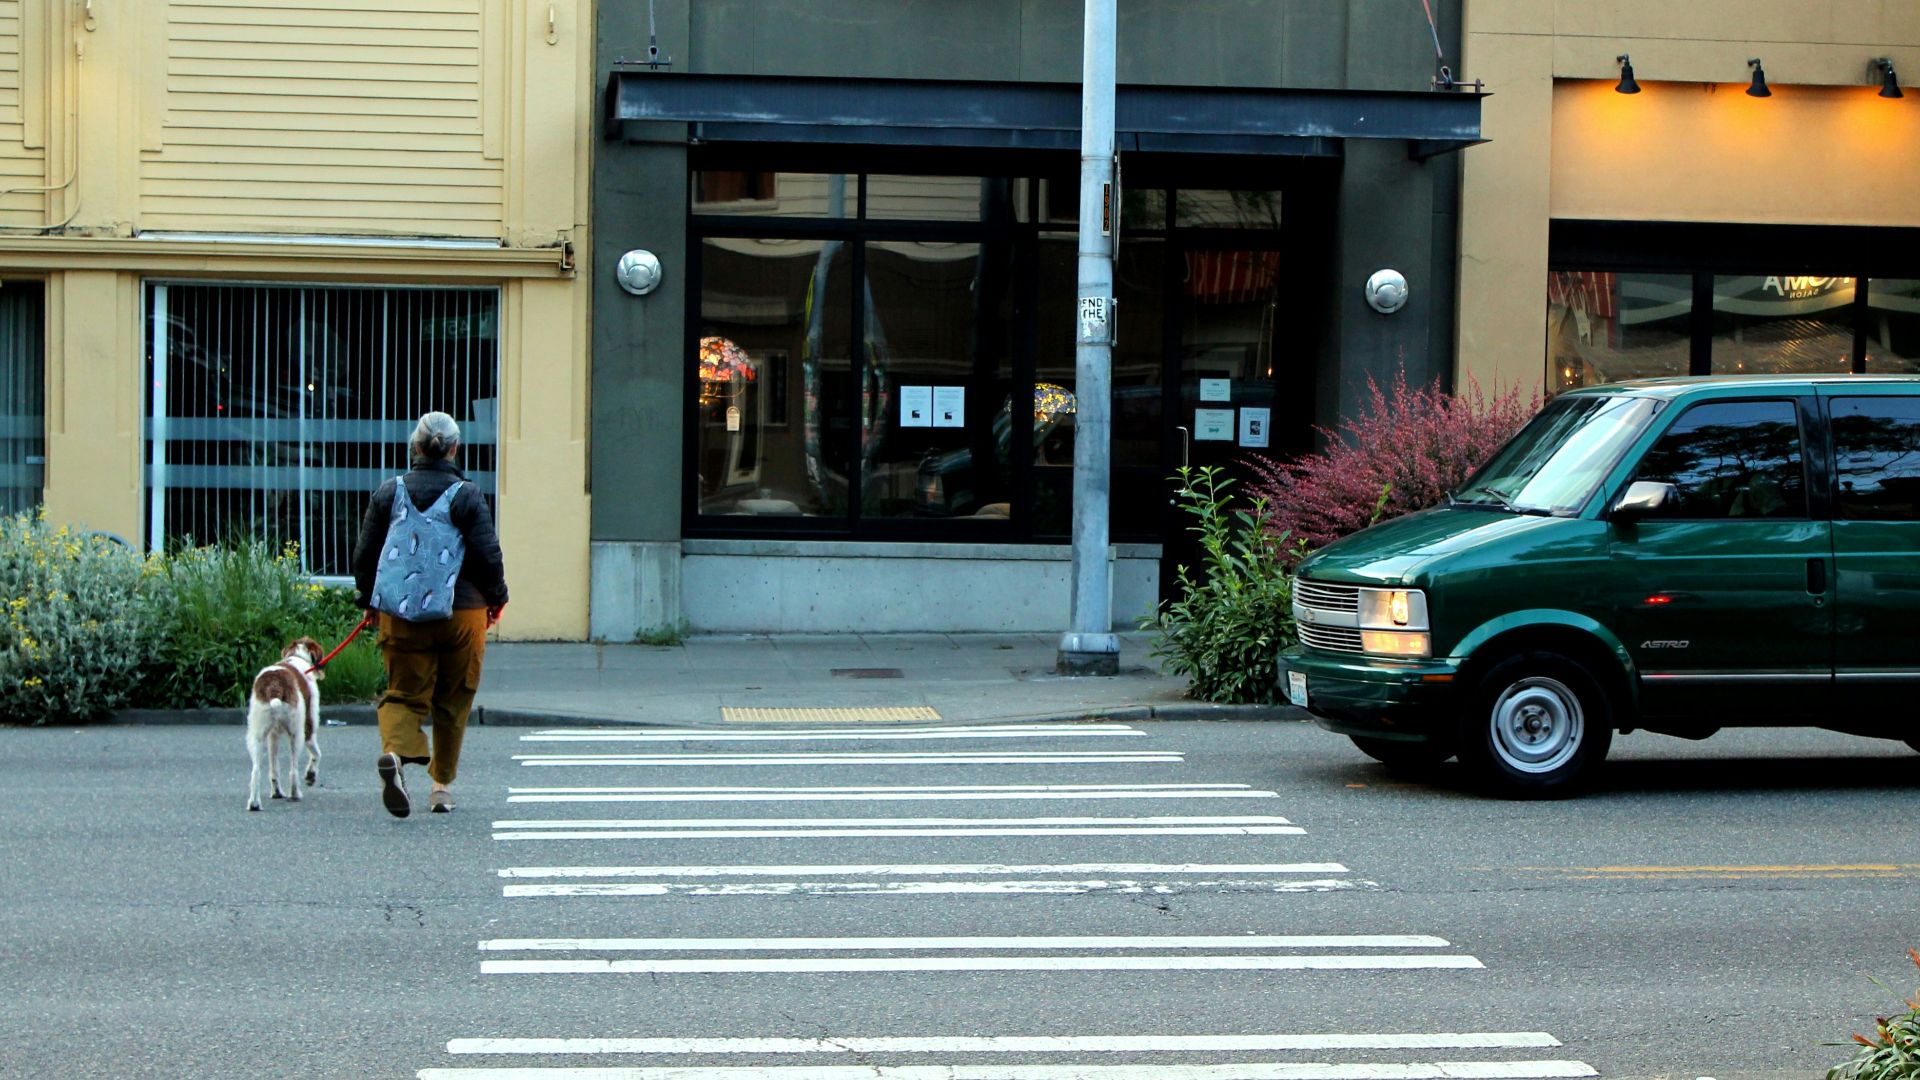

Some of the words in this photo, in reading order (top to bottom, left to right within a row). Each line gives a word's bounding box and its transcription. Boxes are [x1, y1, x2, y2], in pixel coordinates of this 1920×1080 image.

[1081, 298, 1103, 308] END
[1083, 308, 1103, 319] THE
[1640, 640, 1690, 649] ASTRO
